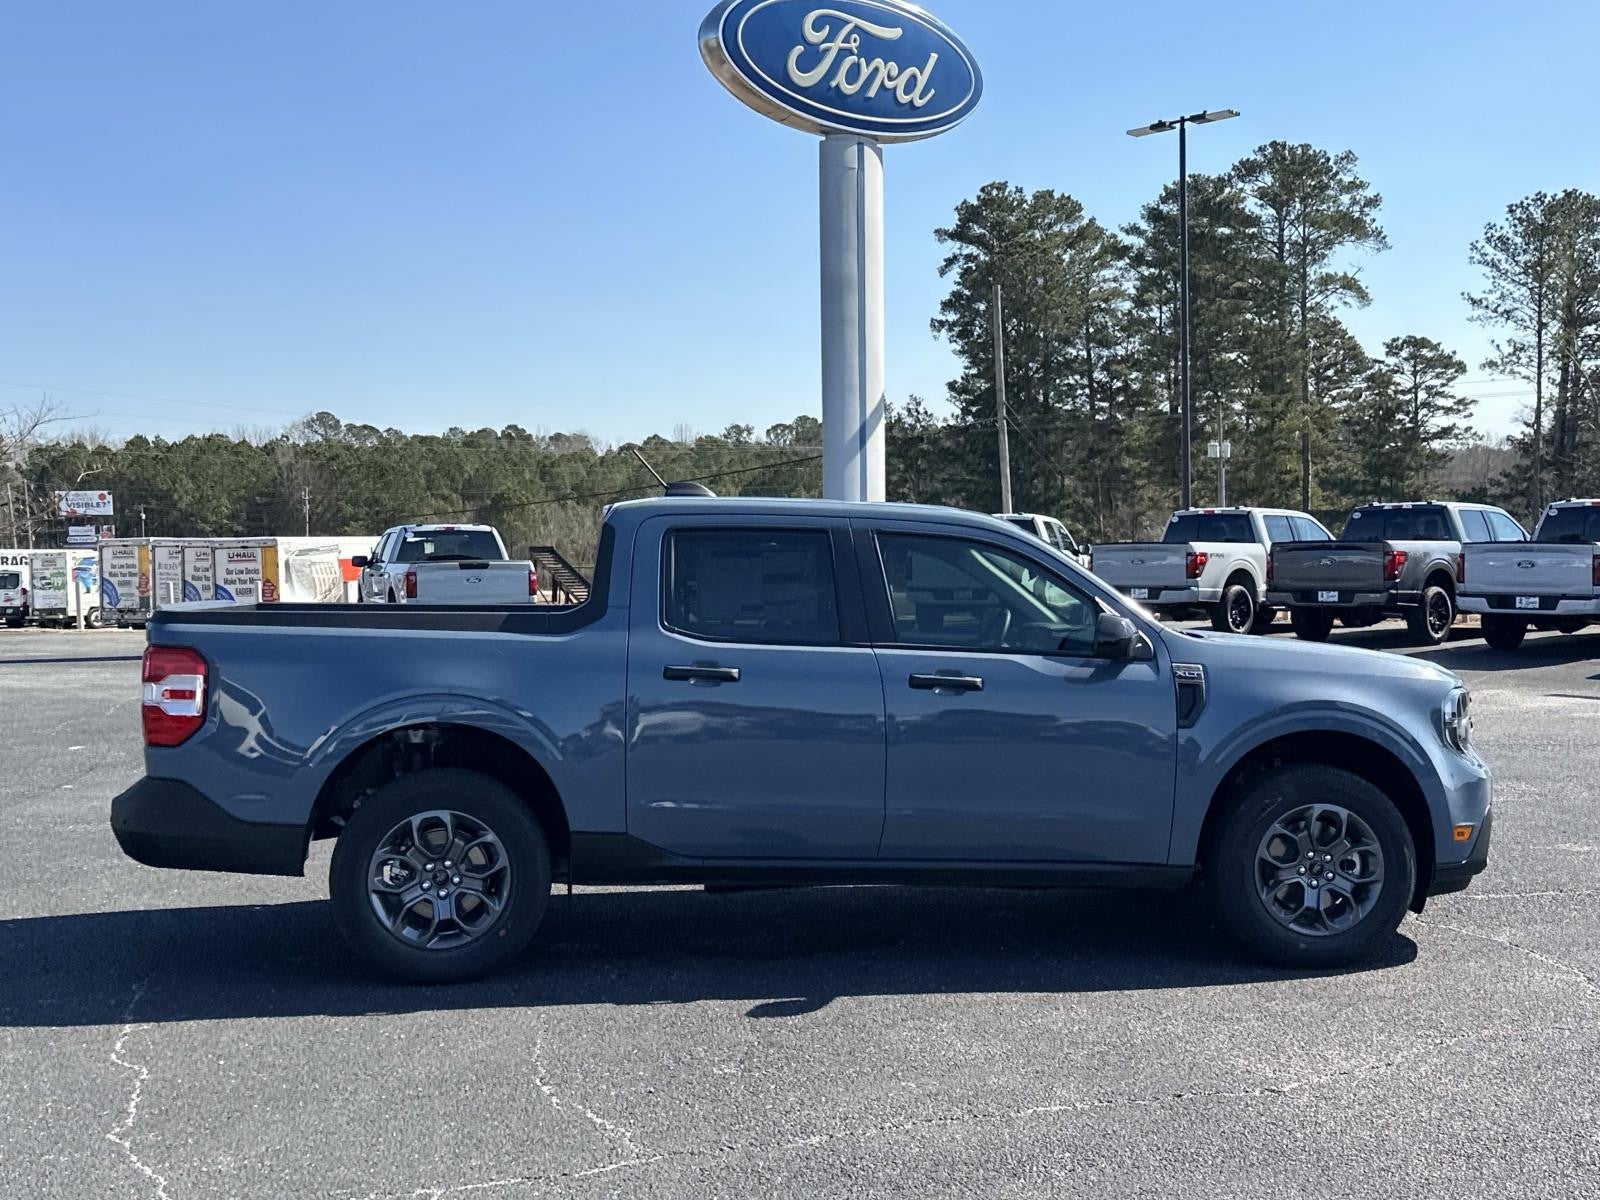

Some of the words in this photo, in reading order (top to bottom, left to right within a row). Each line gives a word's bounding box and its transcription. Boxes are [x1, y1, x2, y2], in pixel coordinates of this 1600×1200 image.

[786, 9, 938, 108] Ford
[228, 551, 257, 559] U-HAUL
[1175, 670, 1201, 678] XLT
